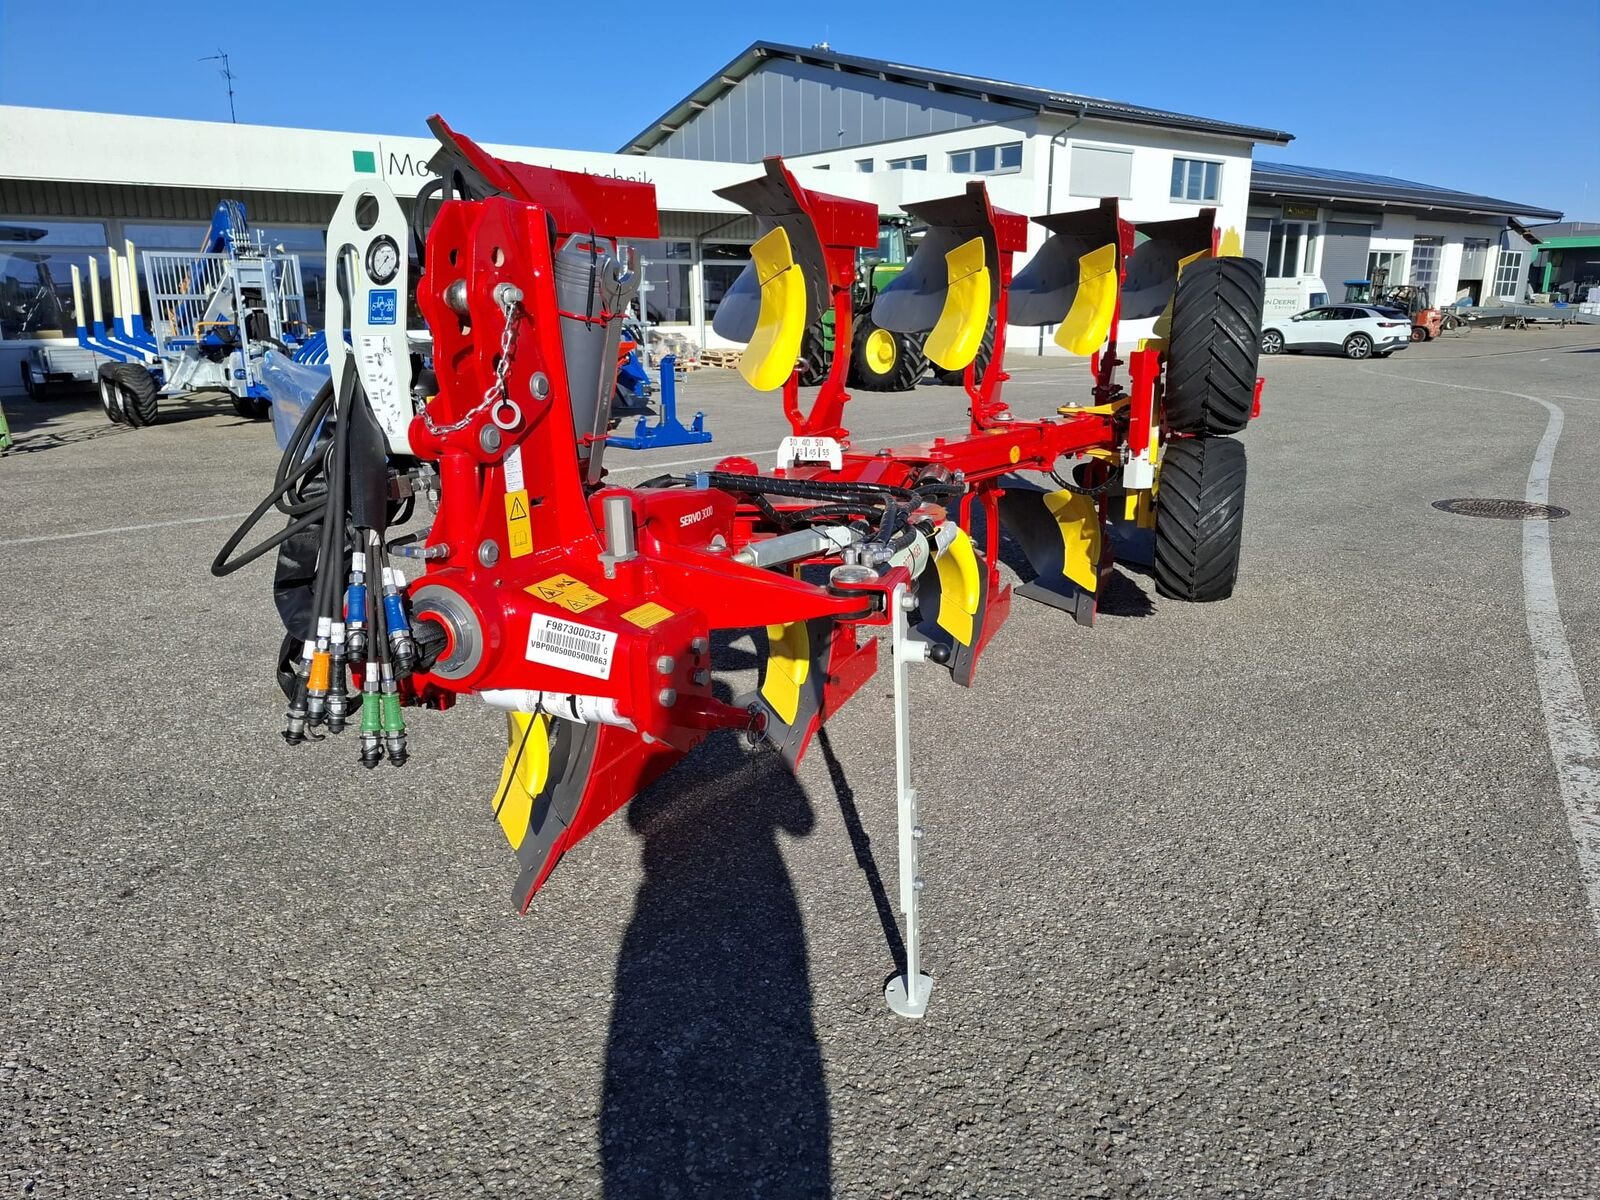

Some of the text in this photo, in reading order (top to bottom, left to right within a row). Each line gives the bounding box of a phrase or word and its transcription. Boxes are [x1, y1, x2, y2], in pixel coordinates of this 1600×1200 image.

[815, 438, 824, 447] 50
[680, 511, 701, 528] SERVO
[546, 619, 607, 642] F9873000331
[531, 639, 608, 666] VBP00050005000863
